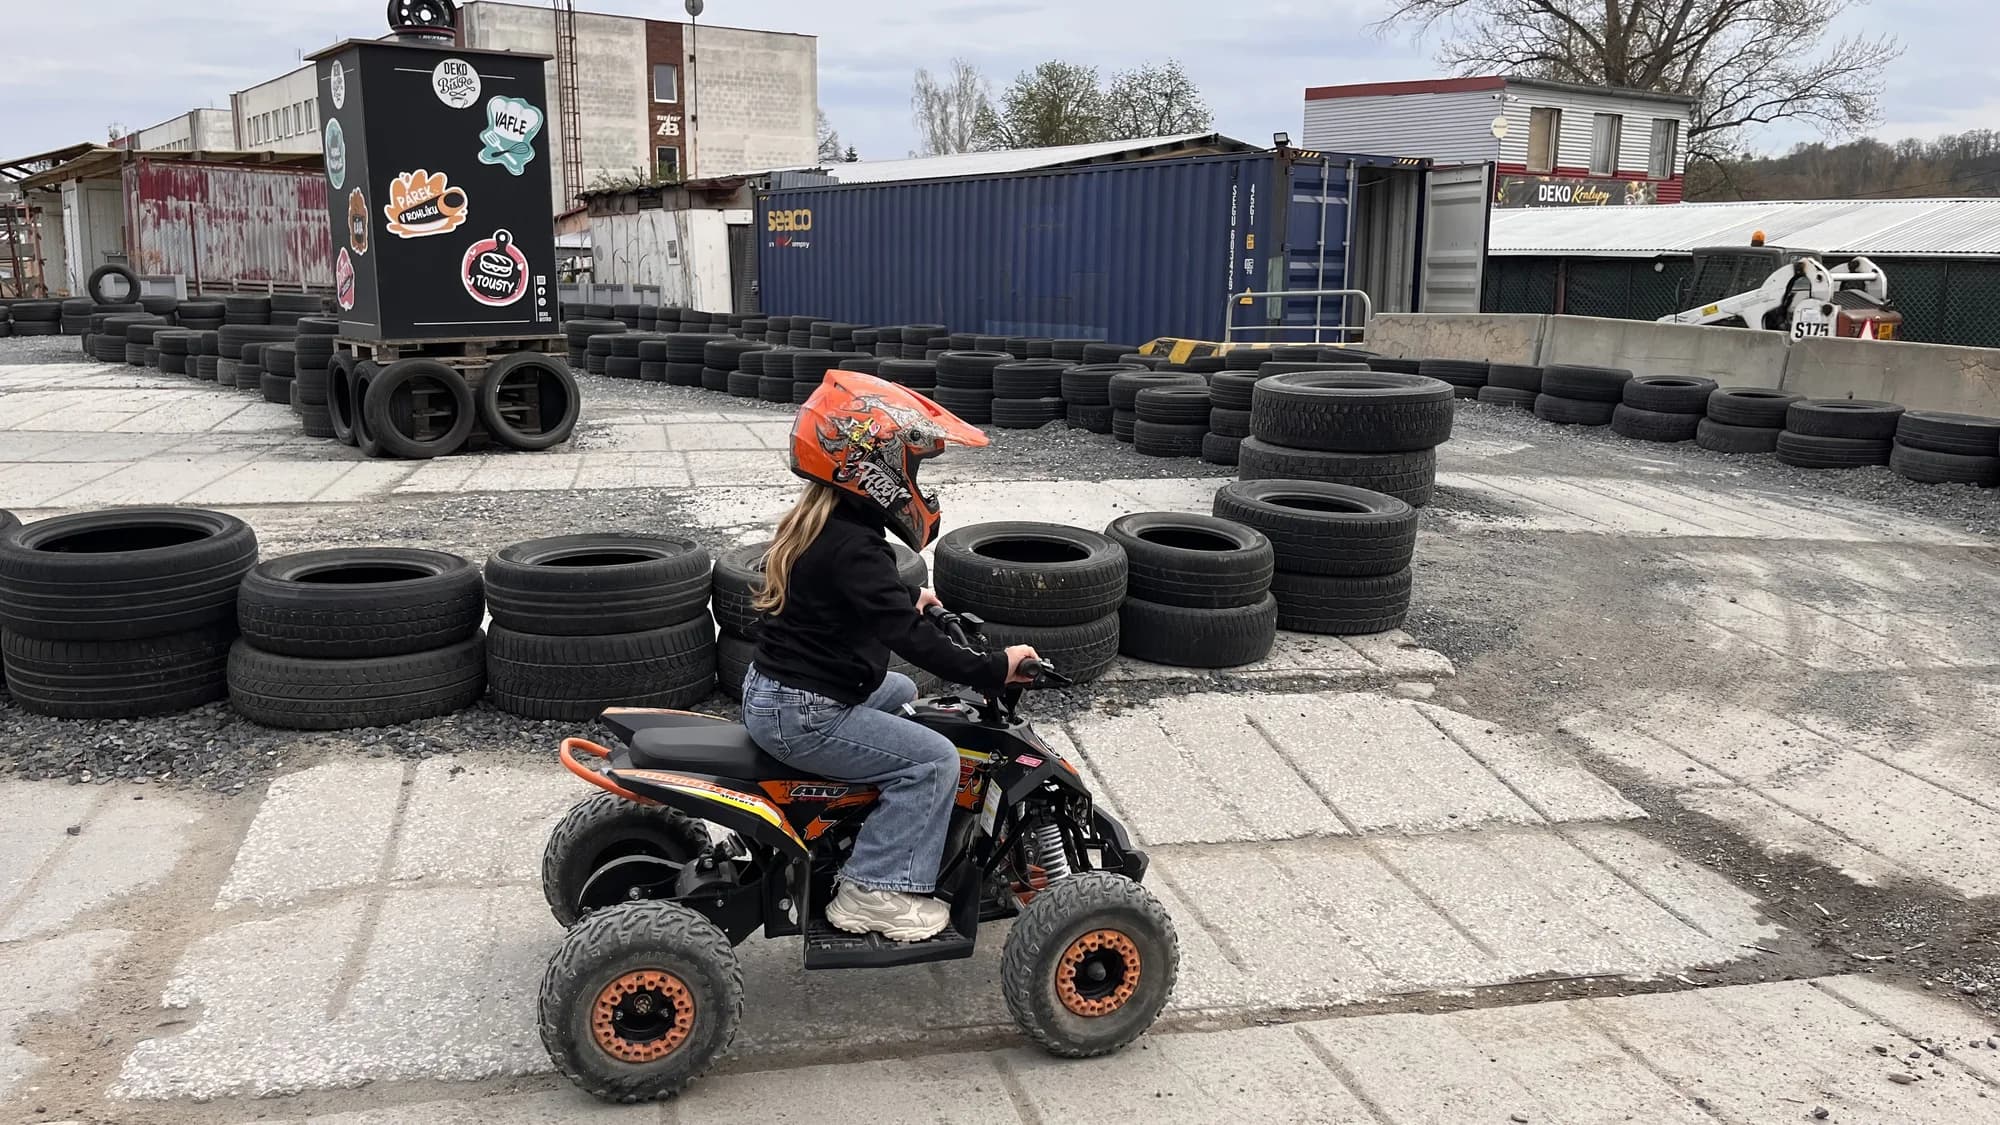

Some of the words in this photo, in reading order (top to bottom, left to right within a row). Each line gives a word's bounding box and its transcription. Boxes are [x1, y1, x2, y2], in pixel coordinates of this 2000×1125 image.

[443, 62, 467, 76] DEKO
[495, 111, 527, 135] VAFLE
[1538, 184, 1571, 203] DEKO
[1571, 184, 1612, 206] Kralupy
[768, 208, 812, 231] seaco
[475, 274, 515, 294] TOUSTY
[1795, 322, 1829, 338] S175
[790, 785, 849, 799] ATV
